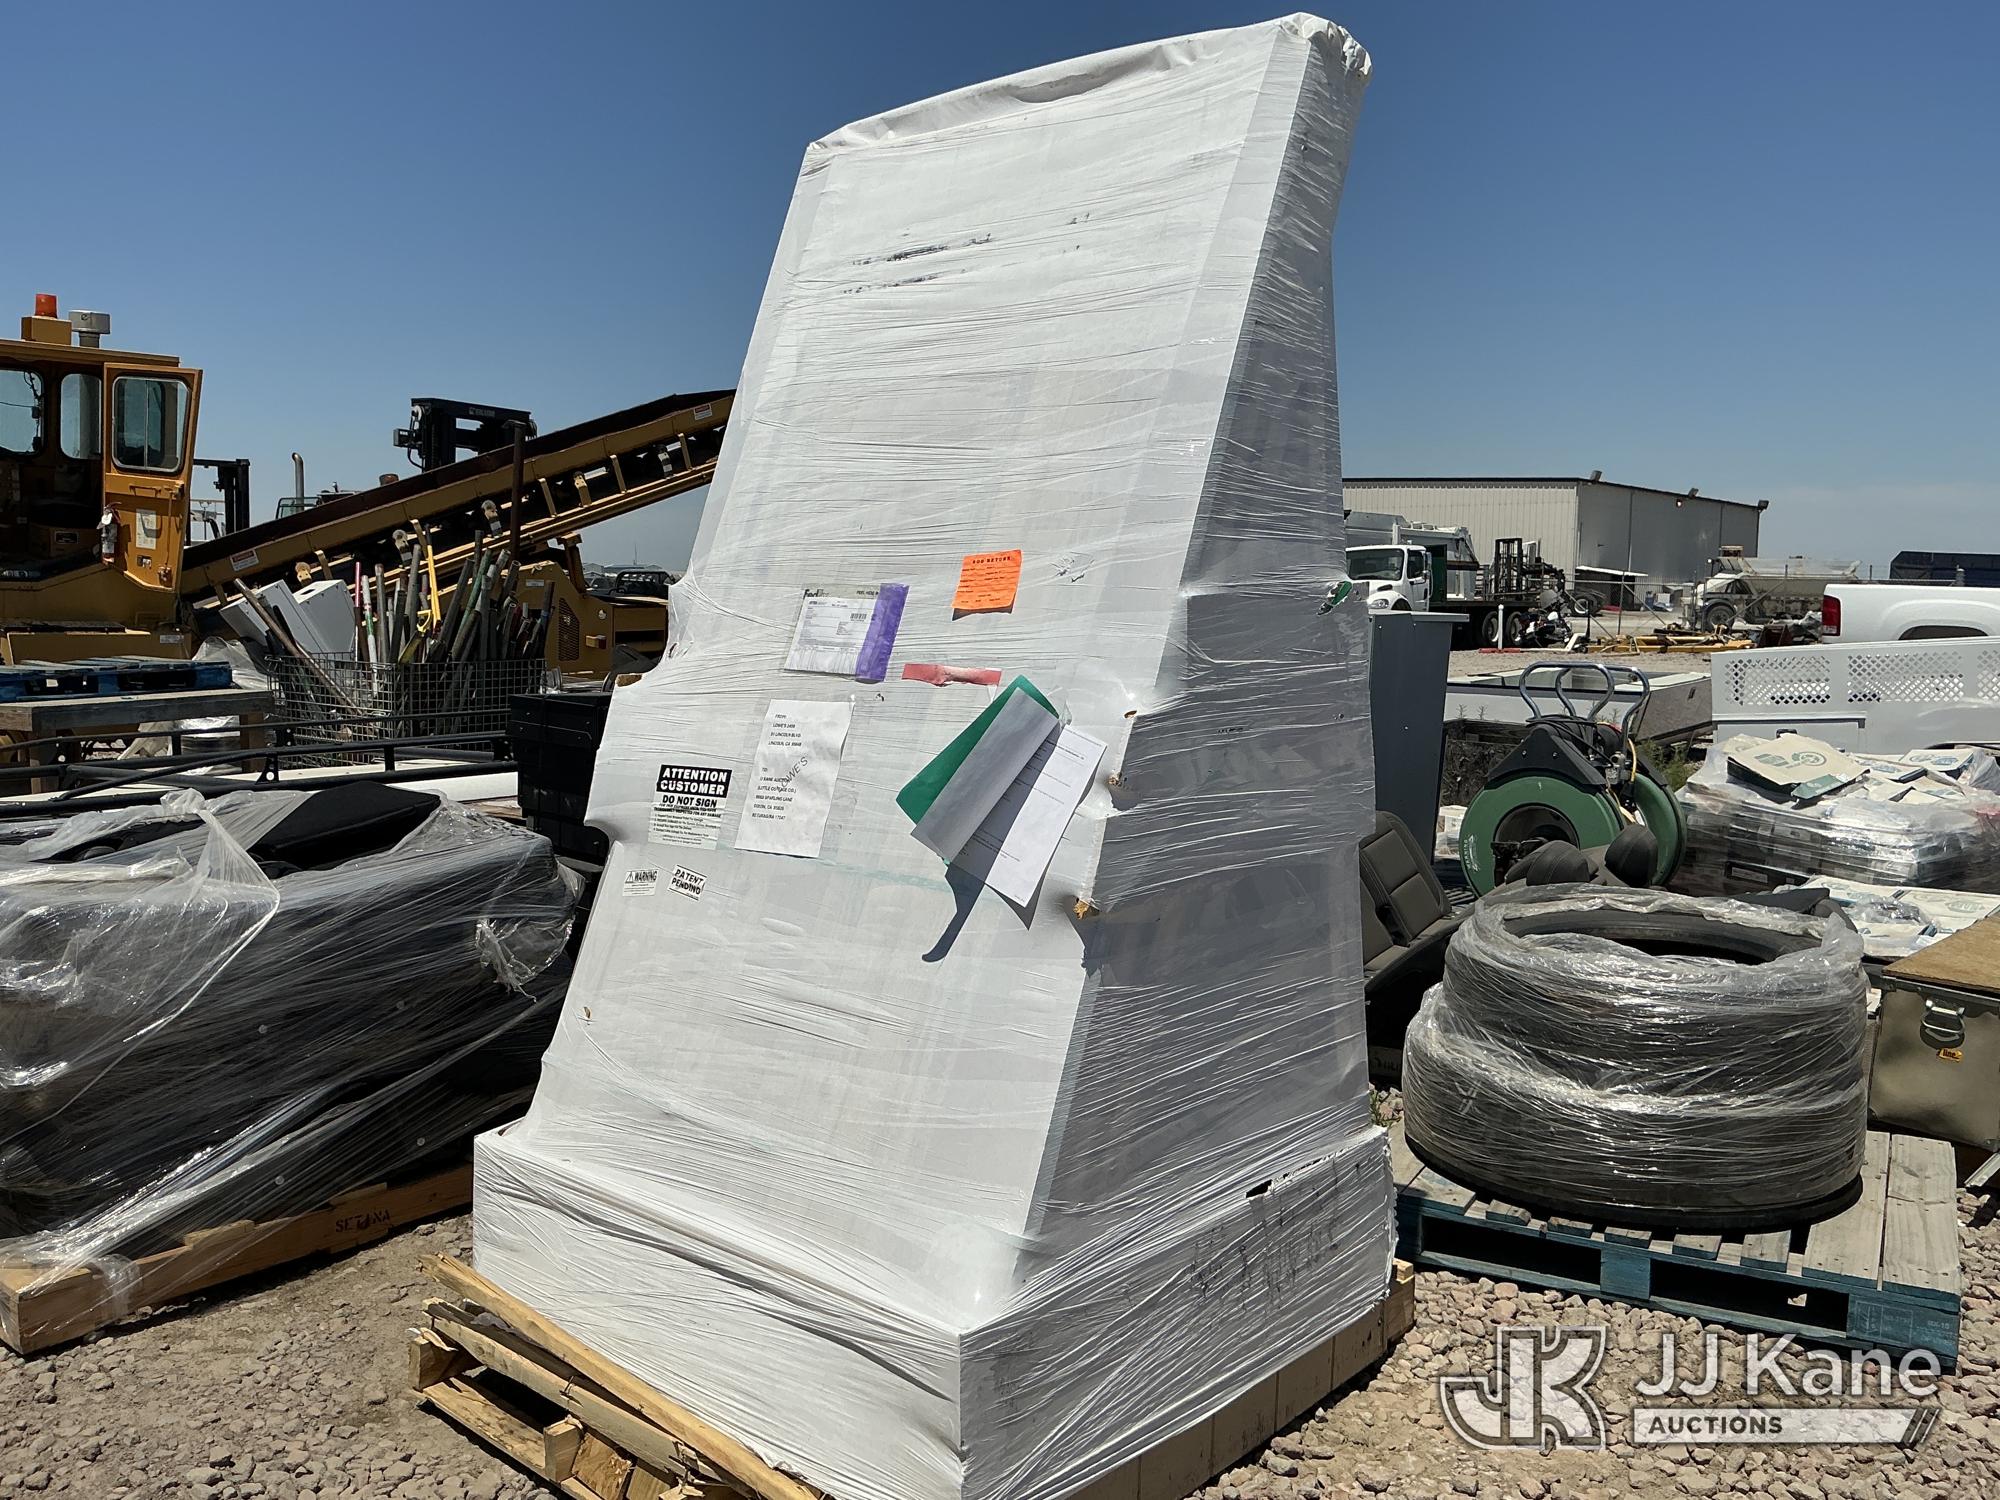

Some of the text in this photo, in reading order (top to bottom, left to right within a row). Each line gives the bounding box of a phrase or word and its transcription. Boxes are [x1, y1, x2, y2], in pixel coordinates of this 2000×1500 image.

[662, 768, 727, 783] ATTENTION
[660, 780, 725, 795] CUSTOMER
[662, 795, 675, 803] DO
[676, 796, 695, 805] NOT
[695, 799, 717, 808] SIGN
[634, 871, 658, 882] WARNING
[674, 869, 704, 885] PATENT
[671, 877, 702, 895] PENDING
